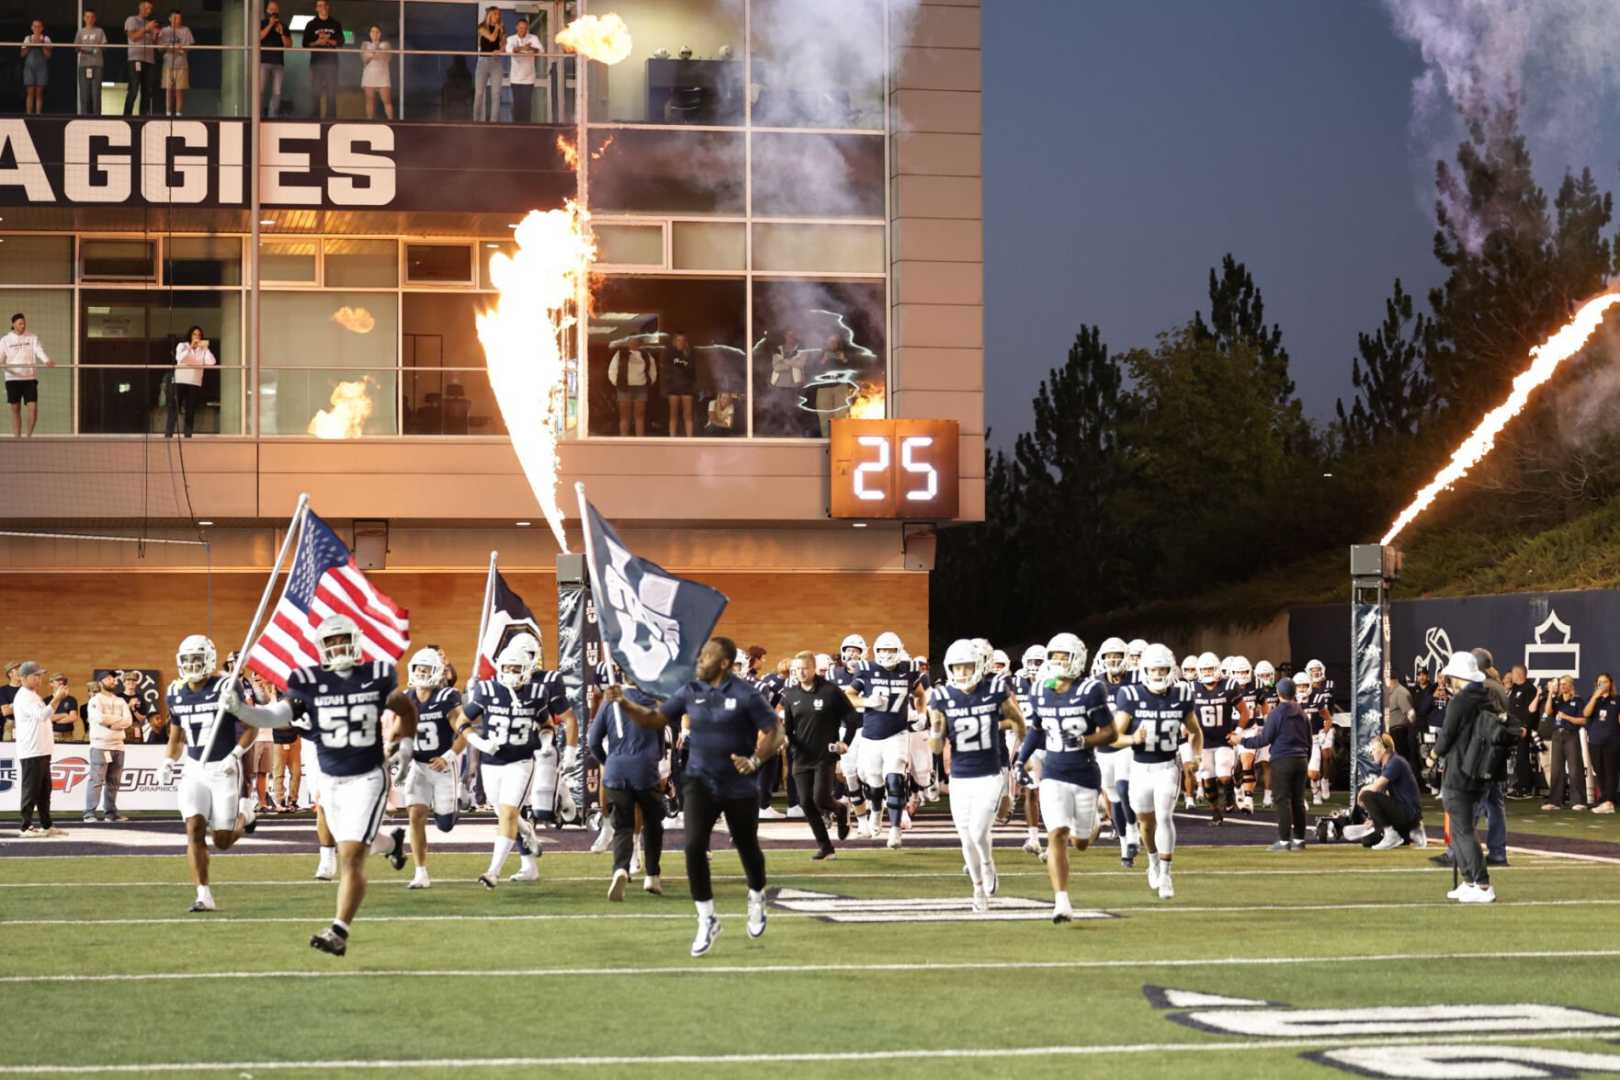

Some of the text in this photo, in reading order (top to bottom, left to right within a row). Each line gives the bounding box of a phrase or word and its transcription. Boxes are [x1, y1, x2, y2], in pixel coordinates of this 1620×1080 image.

[0, 117, 396, 206] AGGIES
[853, 436, 938, 500] 25
[313, 690, 380, 706] UTAH STATE
[1135, 709, 1158, 719] UTAH
[180, 712, 216, 748] 17
[317, 704, 378, 748] 53
[488, 715, 533, 746] 33
[1200, 704, 1224, 727] 61
[953, 714, 992, 752] 21
[1138, 719, 1181, 752] 43
